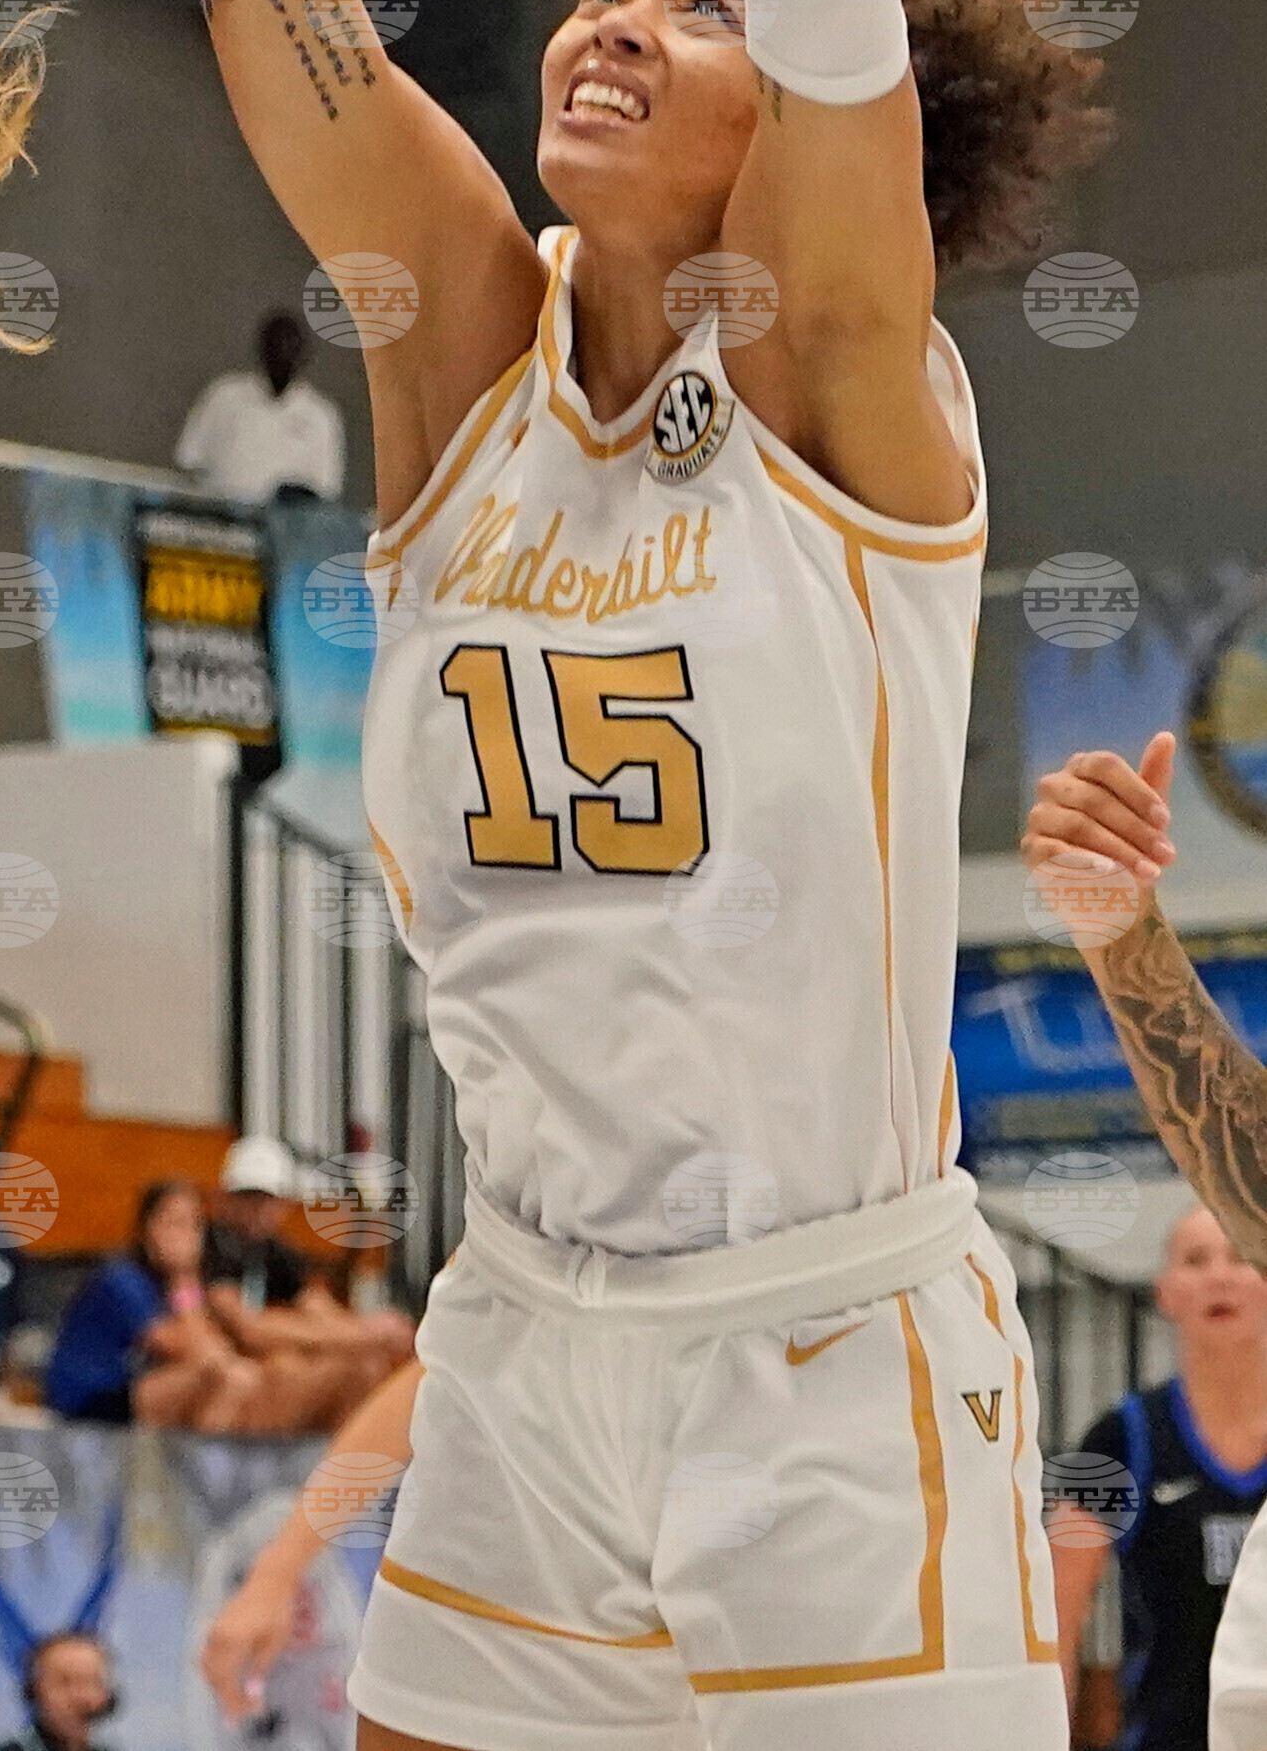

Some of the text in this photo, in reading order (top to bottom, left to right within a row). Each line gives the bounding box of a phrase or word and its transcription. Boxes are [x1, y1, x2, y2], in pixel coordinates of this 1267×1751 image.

[655, 374, 711, 454] SEC
[656, 423, 725, 479] GRADUATE
[439, 643, 709, 876] 15
[961, 1389, 1002, 1442] V
